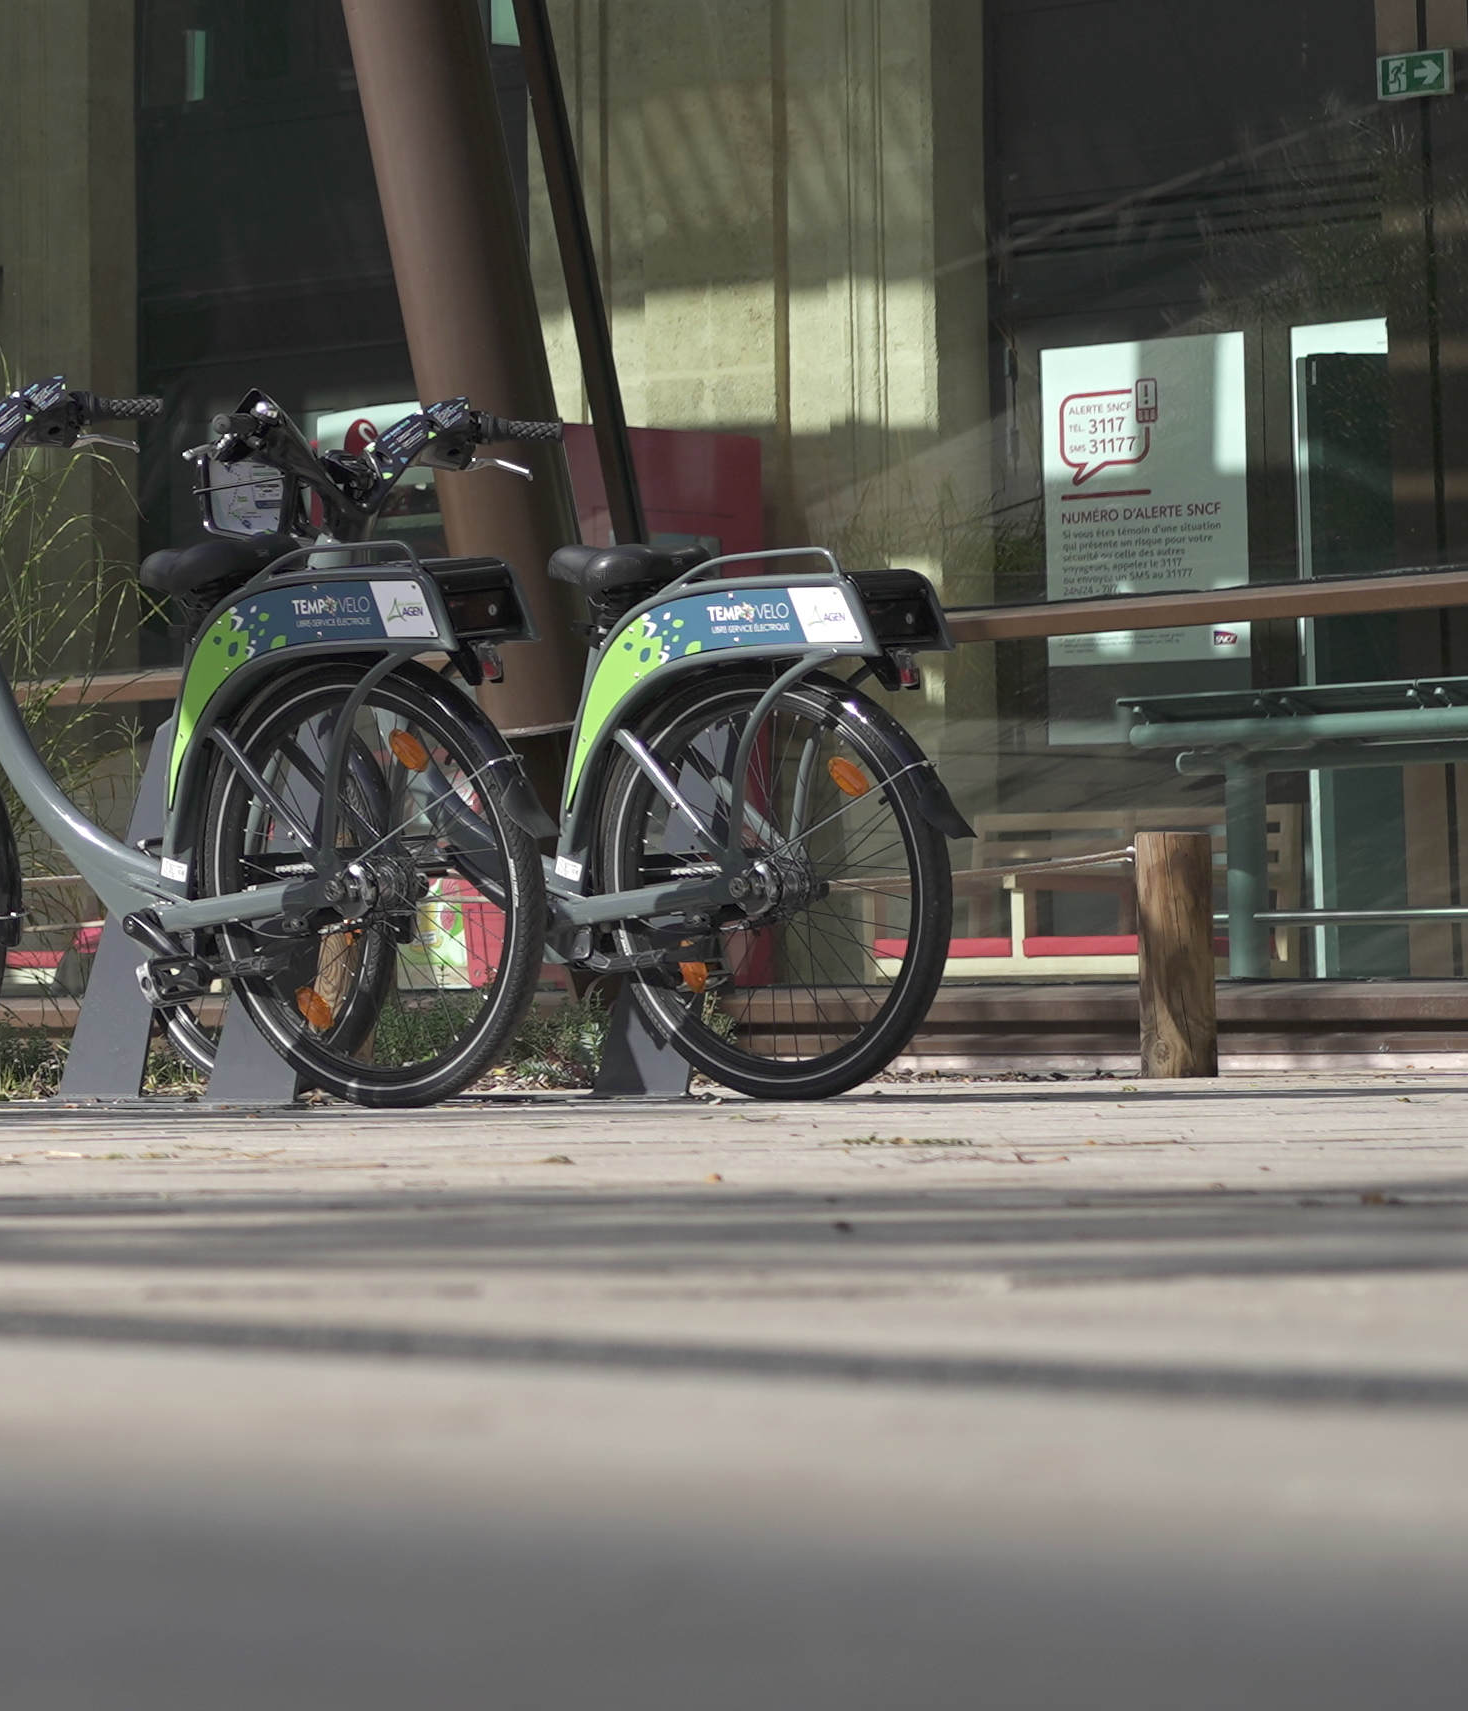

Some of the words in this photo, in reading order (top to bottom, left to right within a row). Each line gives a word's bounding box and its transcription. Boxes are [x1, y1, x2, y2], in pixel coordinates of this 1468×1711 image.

[1068, 403, 1103, 416] ALERTE
[1106, 401, 1132, 413] SNCF
[1088, 416, 1125, 435] 3117
[1069, 445, 1086, 454] SMS
[1089, 436, 1137, 455] 31177
[1061, 506, 1119, 525] NUMÉRO
[1123, 504, 1182, 521] D'ALERTE
[1187, 501, 1222, 517] SNCF
[1063, 530, 1071, 539] Si
[1073, 531, 1094, 539] vous
[1096, 527, 1115, 538] êtes
[1118, 525, 1150, 536] témoin
[1152, 524, 1177, 535] d'une
[1180, 521, 1222, 532] situation
[1063, 541, 1077, 553] qui
[1079, 539, 1118, 551] présente
[1135, 537, 1162, 549] risque
[1164, 536, 1185, 547] pour
[1188, 534, 1213, 543] votre
[1063, 551, 1098, 563] sécurité
[1114, 549, 1136, 558] celle
[1138, 548, 1154, 557] des
[1157, 547, 1185, 556] autres
[1112, 561, 1147, 573] appelez
[1150, 559, 1159, 568] le
[1161, 557, 1182, 567] 3117
[1063, 577, 1075, 585] ou
[1115, 573, 1127, 581] un
[1129, 569, 1150, 579] SMS
[1152, 570, 1163, 579] au
[1165, 568, 1193, 578] 31177
[337, 596, 370, 613] VELO
[402, 606, 424, 616] AGEN
[755, 602, 789, 620] VELO
[824, 613, 846, 621] AGEN
[1215, 635, 1237, 644] SNCF
